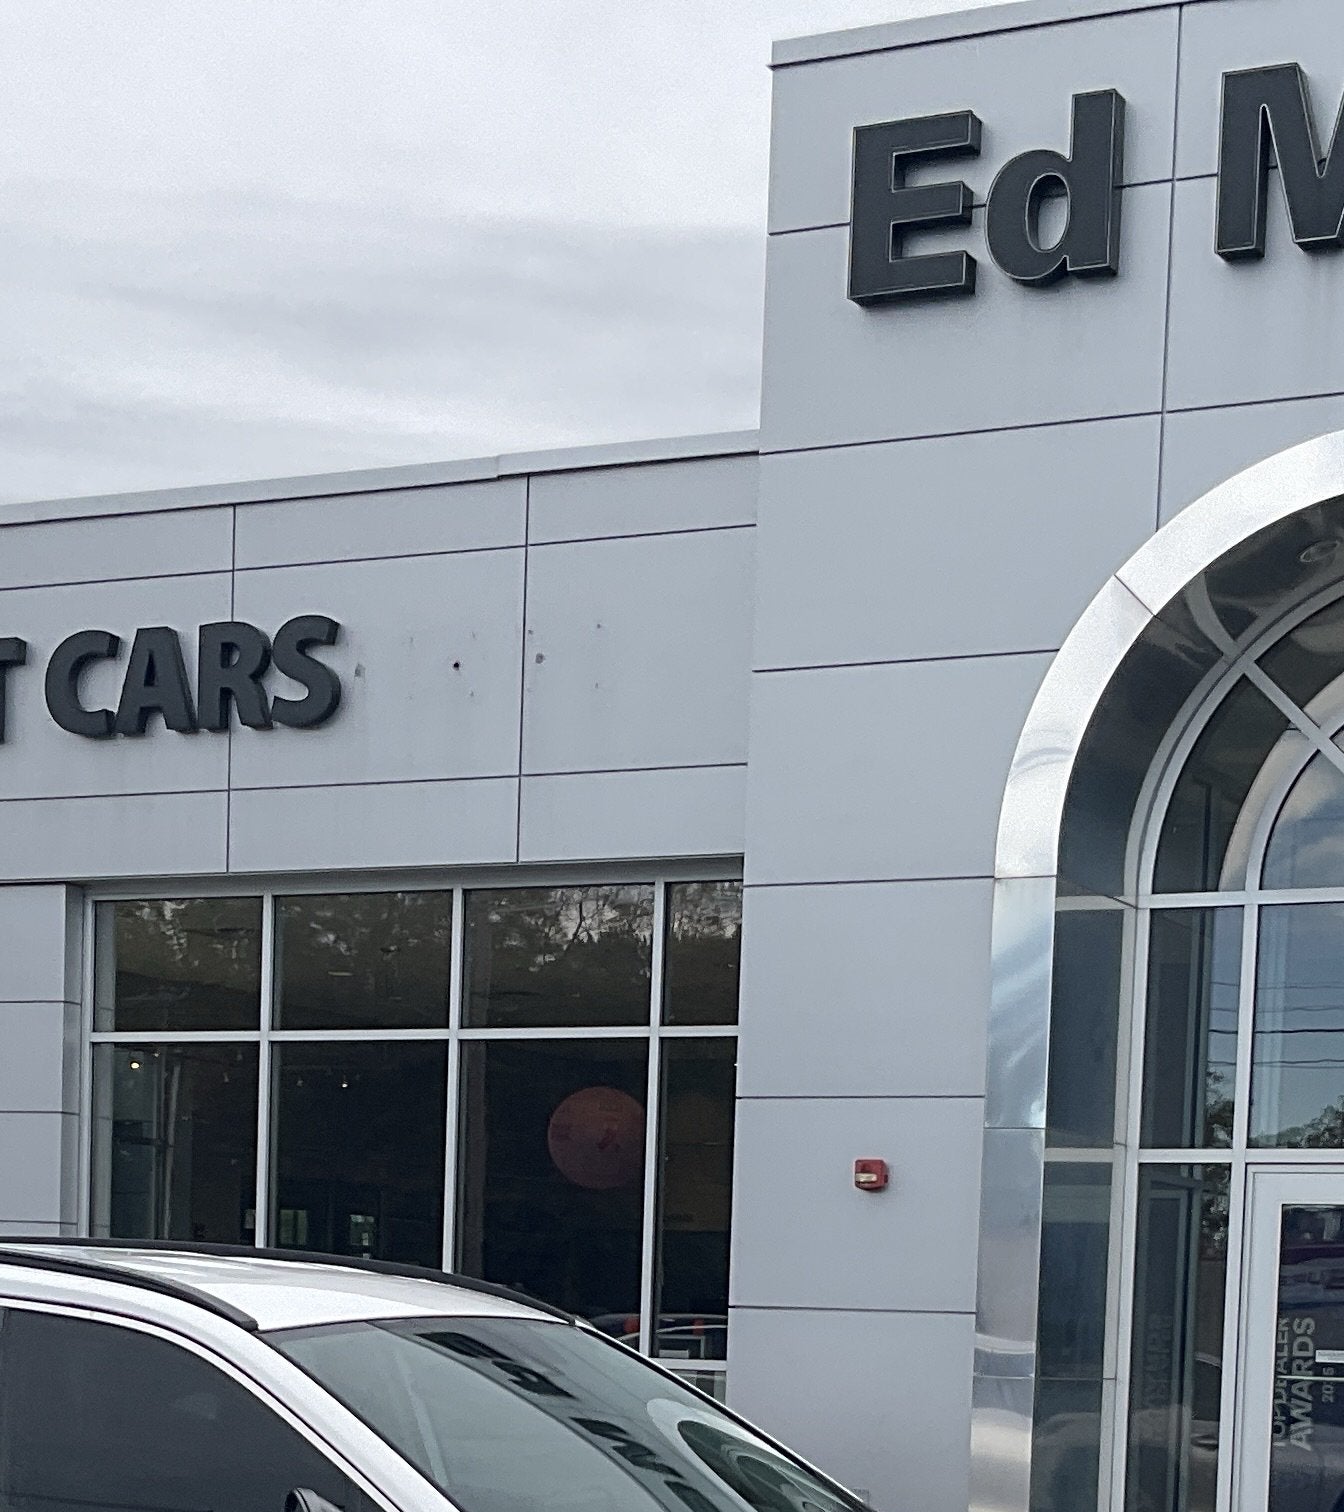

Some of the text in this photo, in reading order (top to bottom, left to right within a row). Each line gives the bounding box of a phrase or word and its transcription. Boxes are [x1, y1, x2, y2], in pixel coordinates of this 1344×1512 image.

[848, 88, 1126, 306] Ed
[45, 614, 341, 738] CARS
[1290, 1317, 1315, 1451] AWARDS
[1321, 1367, 1335, 1403] 205
